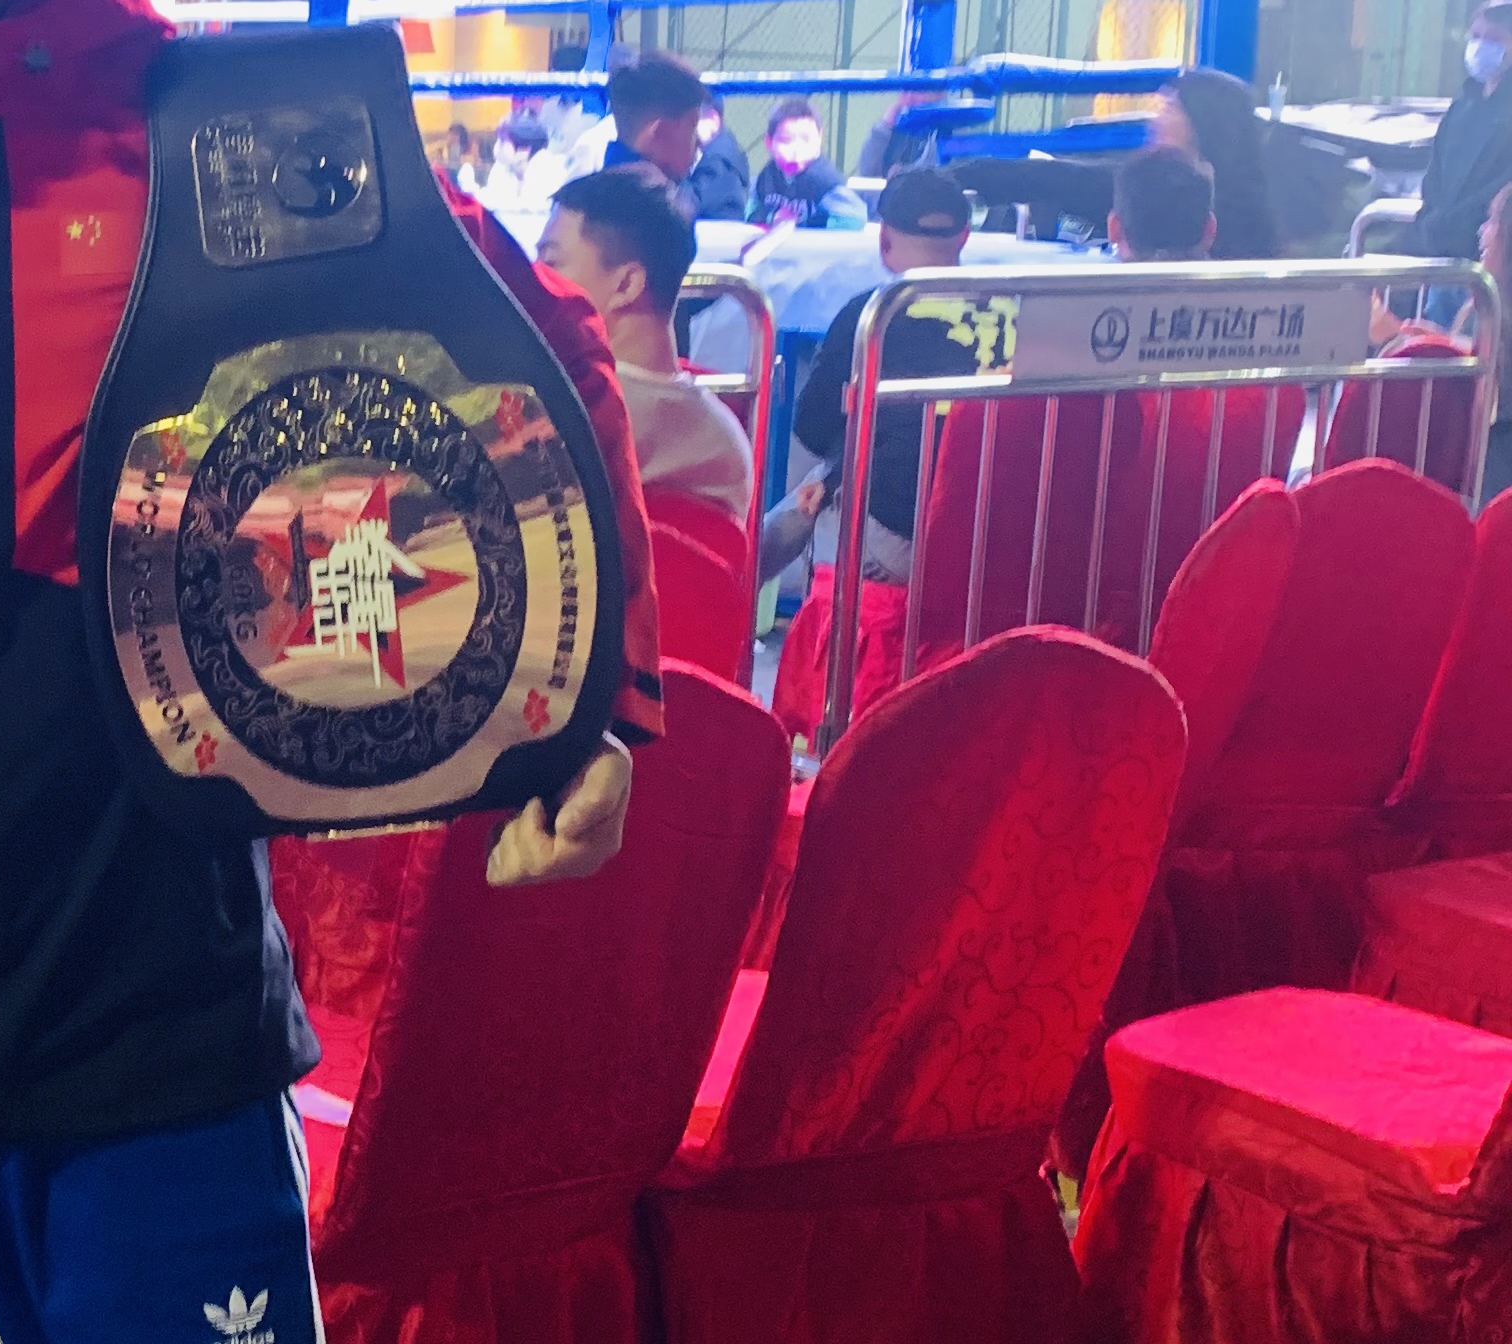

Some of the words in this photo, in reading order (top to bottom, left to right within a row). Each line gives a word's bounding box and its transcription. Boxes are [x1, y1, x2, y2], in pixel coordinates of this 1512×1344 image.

[1140, 304, 1305, 343] 上虞万达广场
